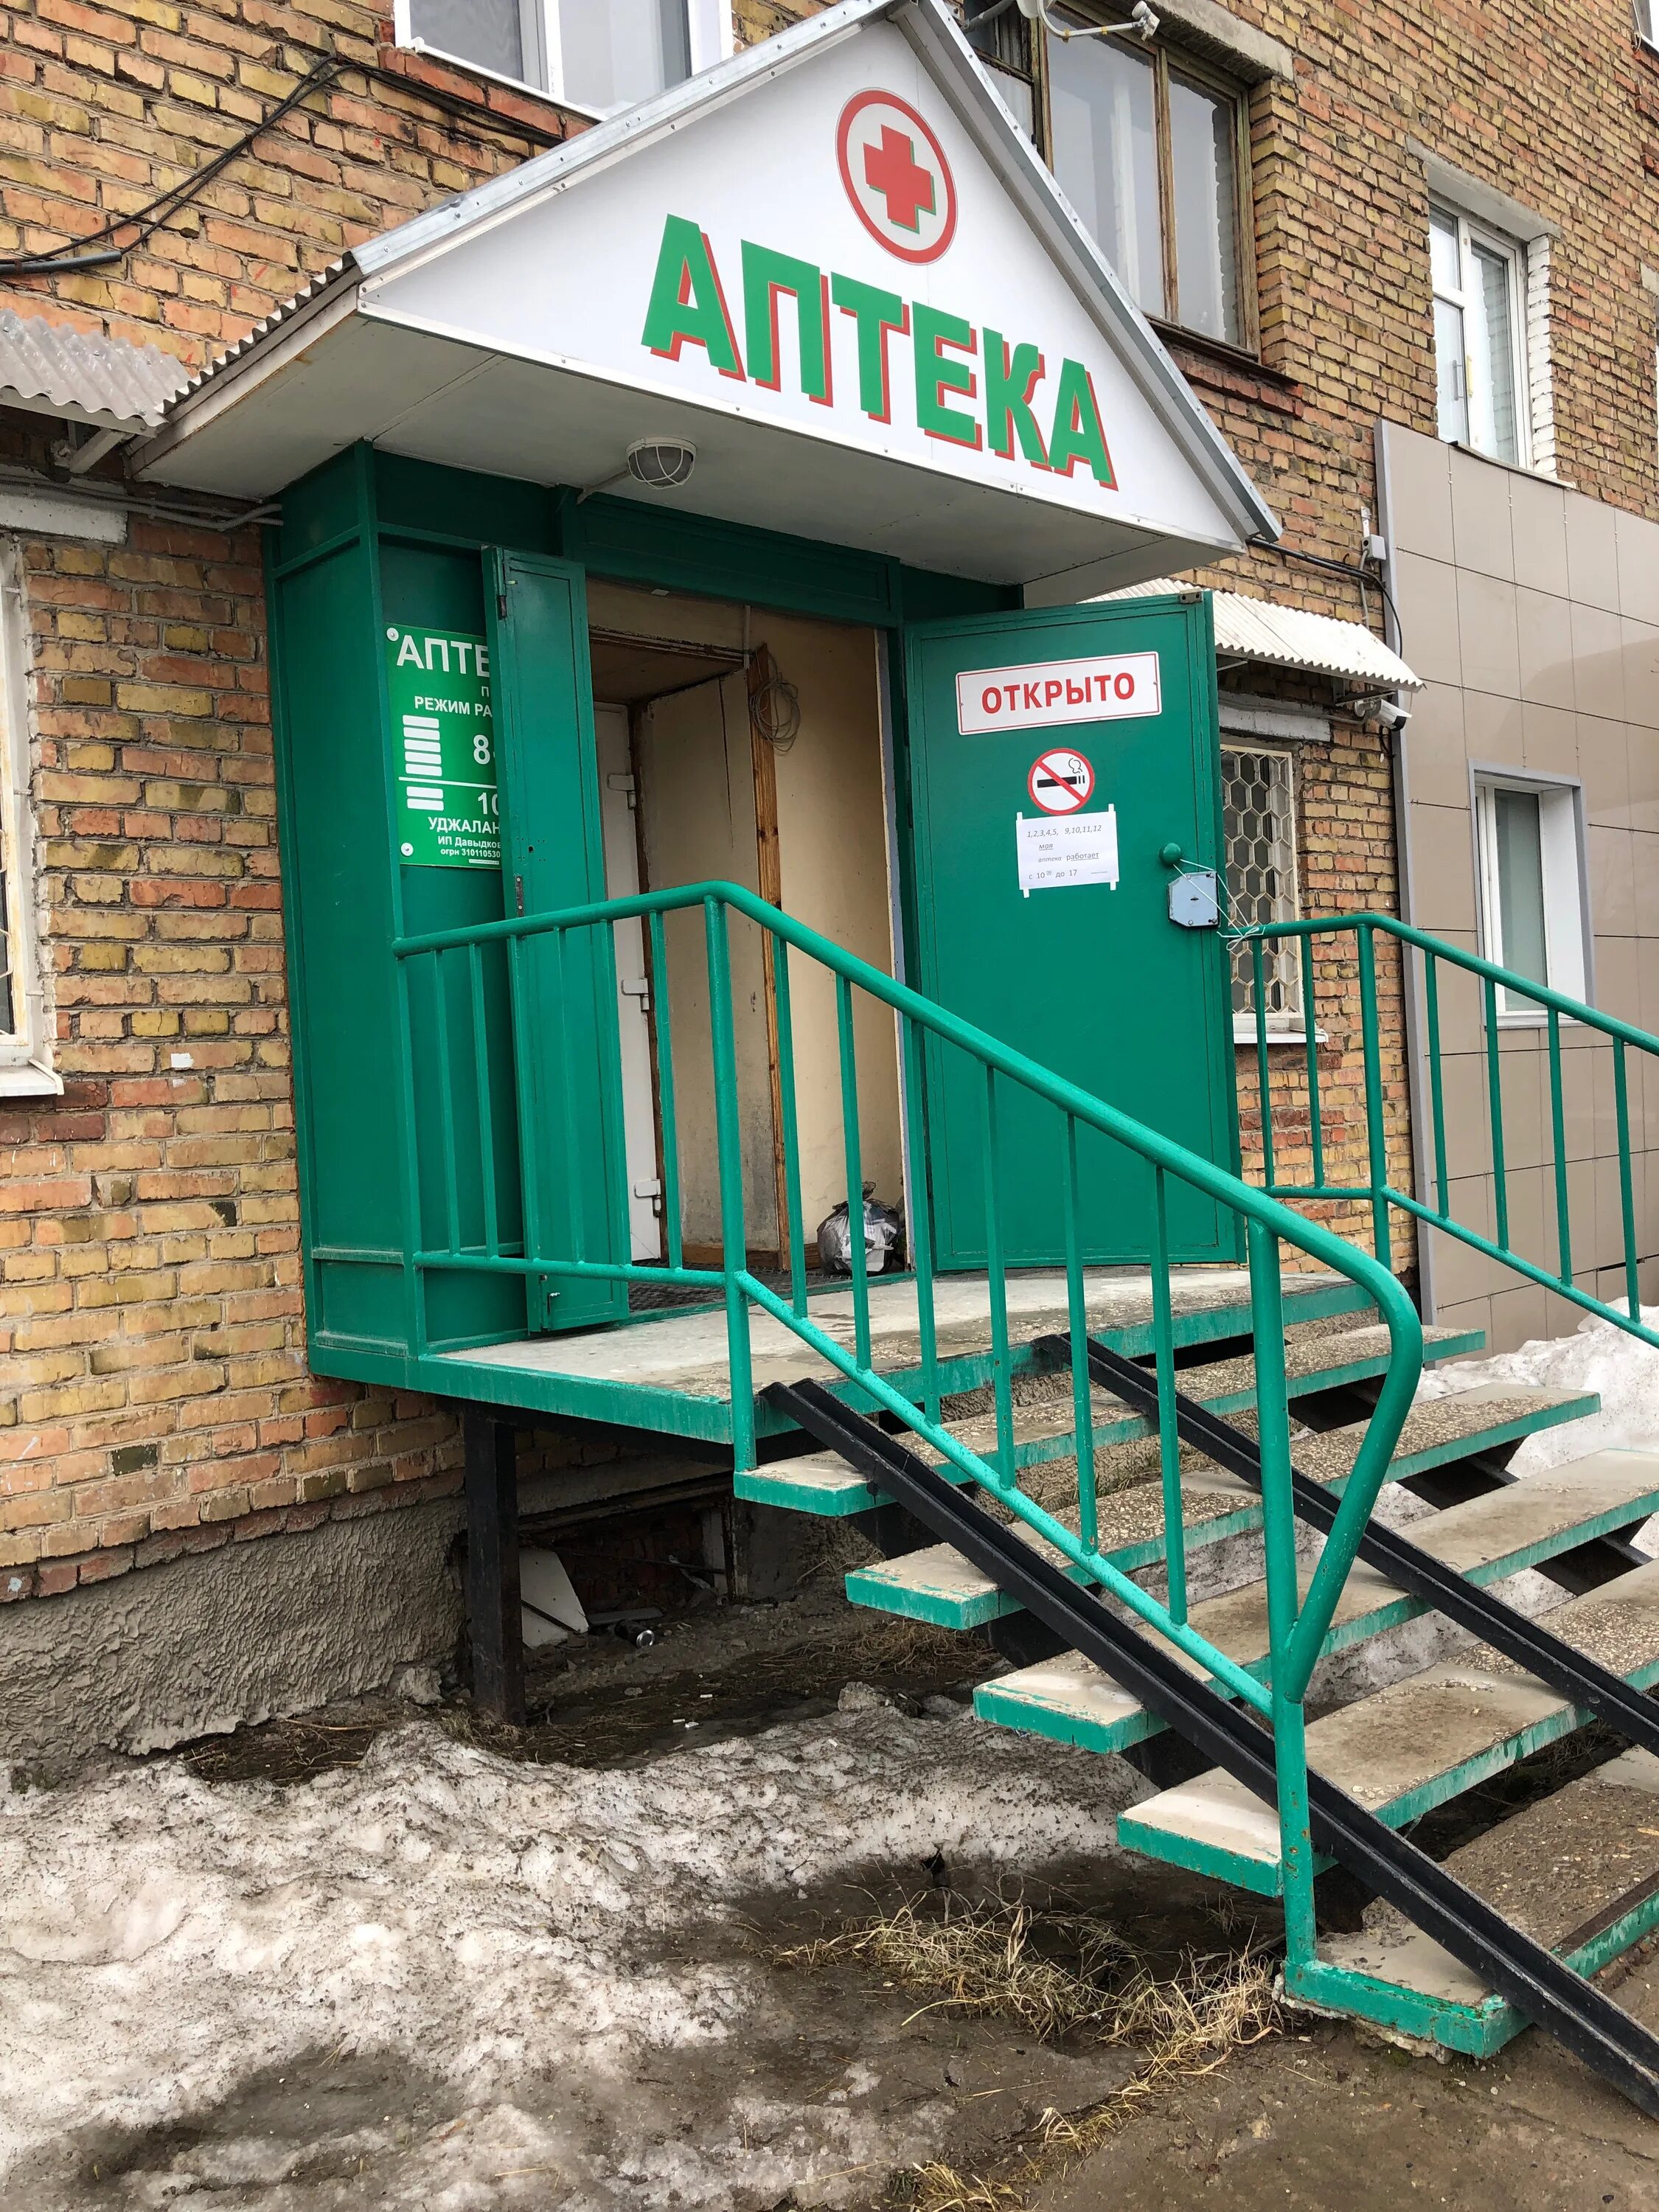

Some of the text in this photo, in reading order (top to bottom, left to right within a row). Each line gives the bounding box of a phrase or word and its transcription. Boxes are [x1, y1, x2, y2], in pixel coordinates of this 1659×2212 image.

[641, 213, 1119, 492] АПТЕКА
[981, 672, 1135, 714] ОТКРЫТО
[414, 695, 470, 715] РЕЖИМ
[473, 734, 495, 765] 8
[1027, 824, 1102, 838] 1,2,3,4,5, 9,10,11,12
[437, 835, 452, 845] ИП
[441, 848, 459, 857] огрн
[1066, 852, 1099, 861] работает
